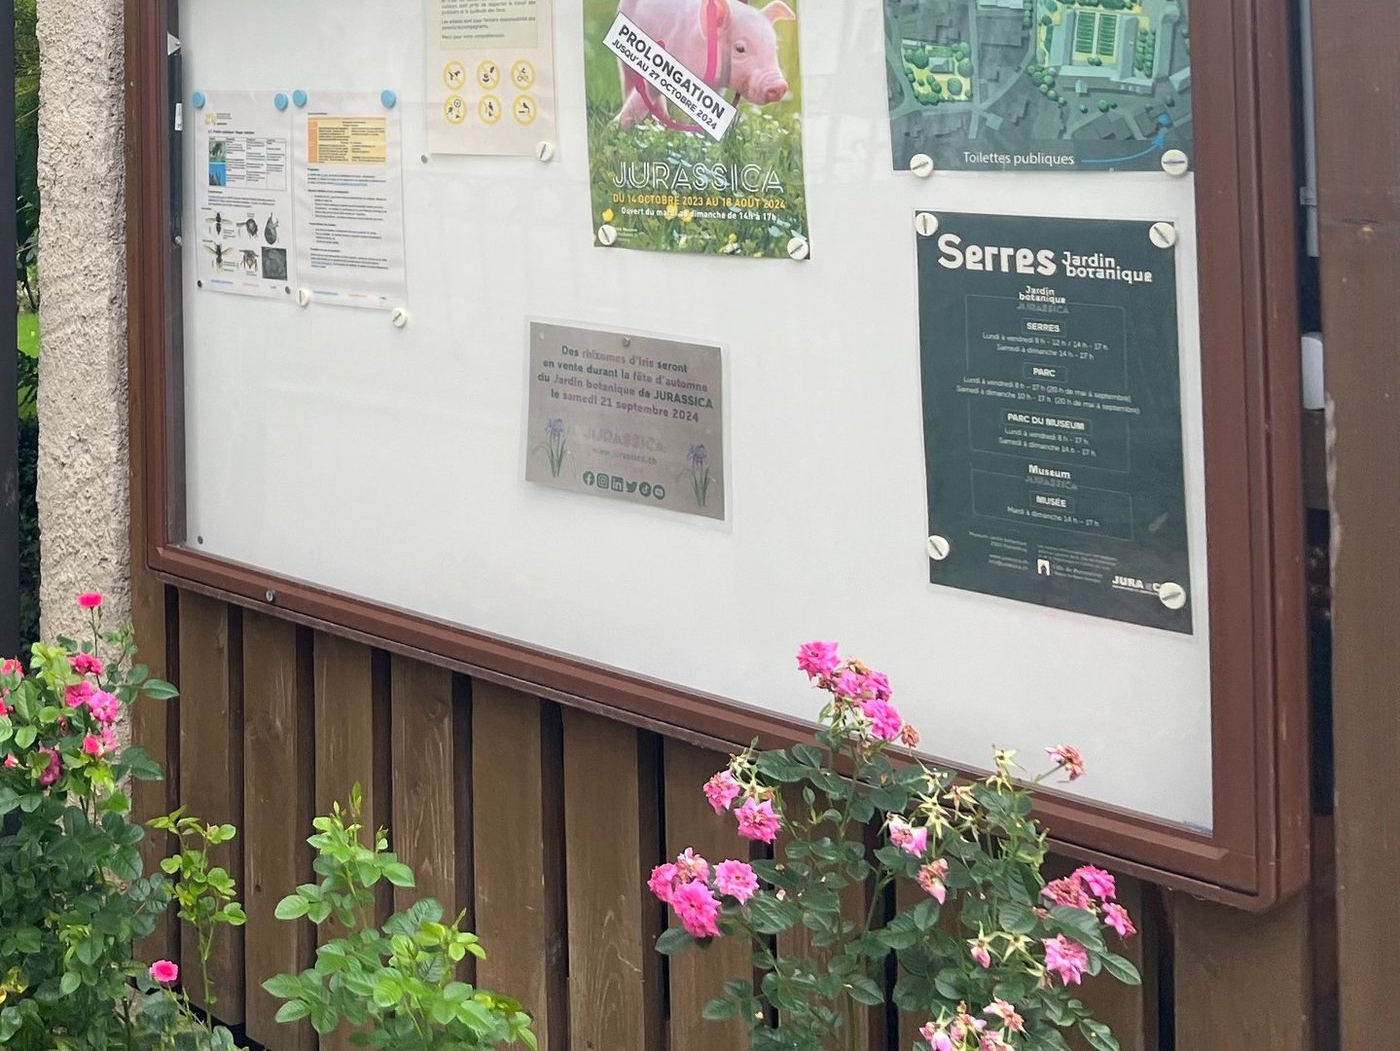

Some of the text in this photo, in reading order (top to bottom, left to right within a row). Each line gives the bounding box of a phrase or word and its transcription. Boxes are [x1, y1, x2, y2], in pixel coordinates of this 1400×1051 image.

[619, 25, 725, 118] PROLONGATION
[649, 70, 660, 80] 27
[660, 79, 697, 112] OCTOBRE
[697, 110, 717, 129] 2024
[964, 151, 1075, 167] Toilettes publiques
[613, 161, 783, 193] JURASSICA
[613, 194, 624, 202] DU
[628, 194, 637, 203] 14
[638, 194, 680, 205] OCTOBRE
[682, 196, 703, 206] 2023
[706, 197, 719, 206] AU
[763, 199, 785, 209] 2024
[621, 207, 643, 215] Ouvert
[645, 207, 654, 215] du
[691, 209, 725, 219] dimanche
[727, 211, 736, 219] de
[937, 233, 1057, 277] Serres
[1062, 251, 1115, 268] Jardin
[1066, 264, 1152, 284] botanique
[1019, 292, 1066, 304] botanique
[1027, 322, 1060, 332] SERRES
[562, 346, 579, 357] Des
[658, 361, 687, 373] seront
[543, 360, 554, 368] en
[558, 361, 583, 372] vente
[587, 365, 618, 377] durant
[622, 369, 629, 379] la
[656, 375, 708, 392] d'automne
[1033, 368, 1056, 377] PARC
[538, 372, 713, 409] du Jardin botanique de JURASSICA
[551, 388, 698, 422] le samedi 21 septembre 2024
[1008, 413, 1030, 423] PARC
[1032, 416, 1044, 425] DU
[1029, 464, 1070, 479] Museum
[1112, 576, 1144, 589] JURA
